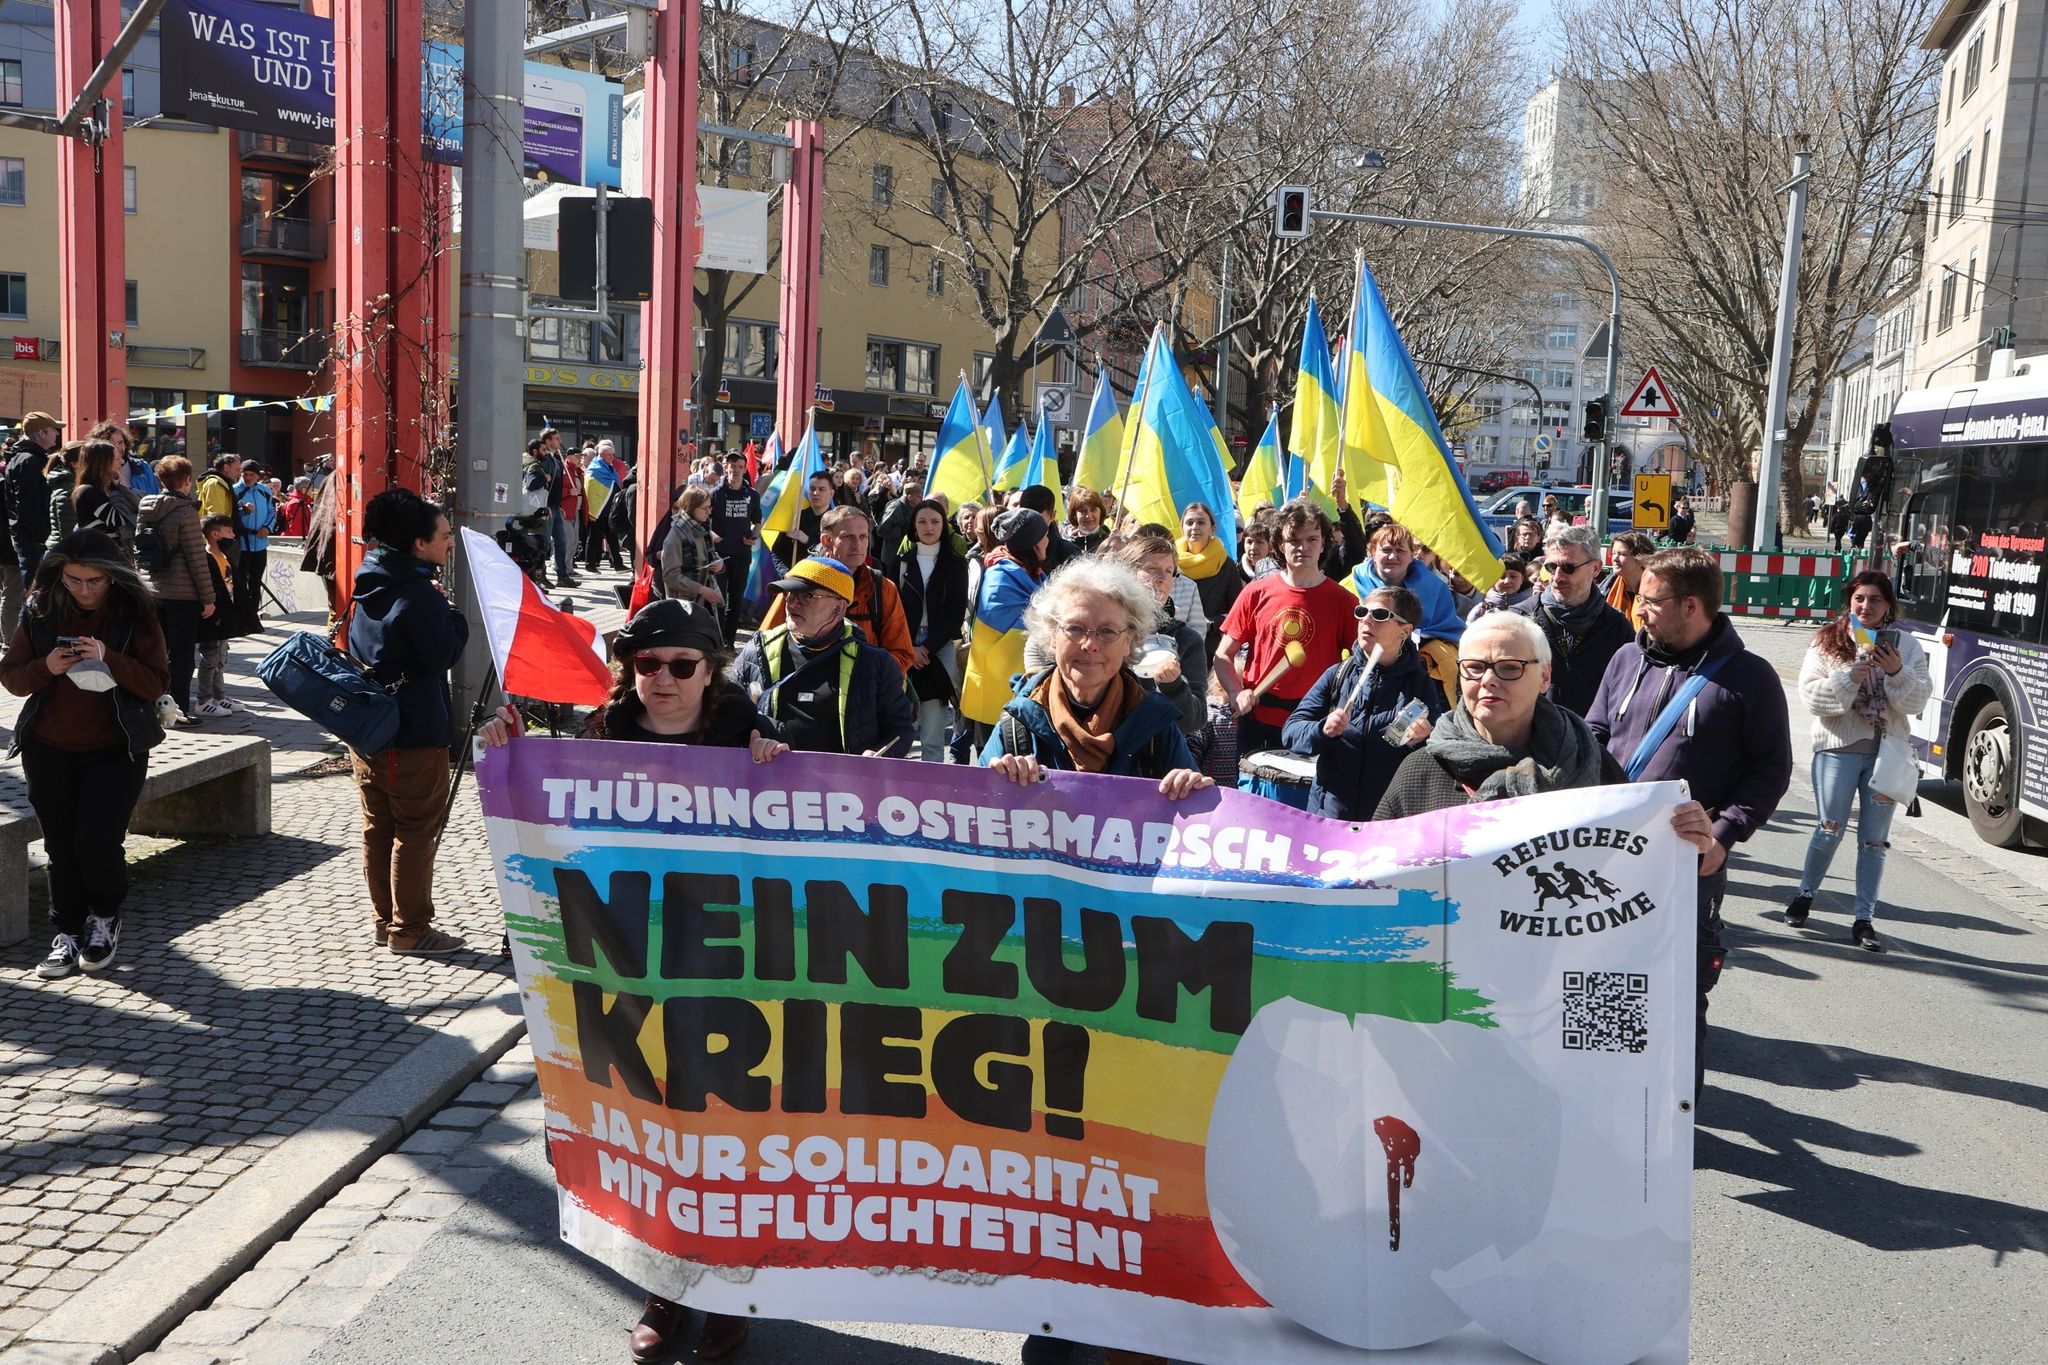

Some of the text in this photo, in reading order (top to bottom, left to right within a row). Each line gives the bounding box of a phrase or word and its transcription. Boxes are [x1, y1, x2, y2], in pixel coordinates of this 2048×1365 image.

[189, 11, 336, 67] WAS IST L
[252, 55, 312, 91] UND
[15, 342, 34, 354] ibis
[1641, 481, 1649, 491] U
[1951, 549, 2041, 584] Über 200 Todesopfer
[1993, 591, 2013, 614] seit
[2012, 592, 2036, 617] 1990
[543, 772, 866, 834] THÜRINGER
[877, 795, 1292, 873] OSTERMARSCH
[1491, 826, 1649, 877] REFUGEES
[1499, 890, 1656, 937] WELCOME
[554, 866, 1255, 1036] NEIN ZUM
[572, 979, 1091, 1142] KRIEG!
[591, 1100, 1159, 1224] JA ZUR SOLIDARITÄT
[597, 1148, 1143, 1276] MIT GEFLÜCHTETEN!
